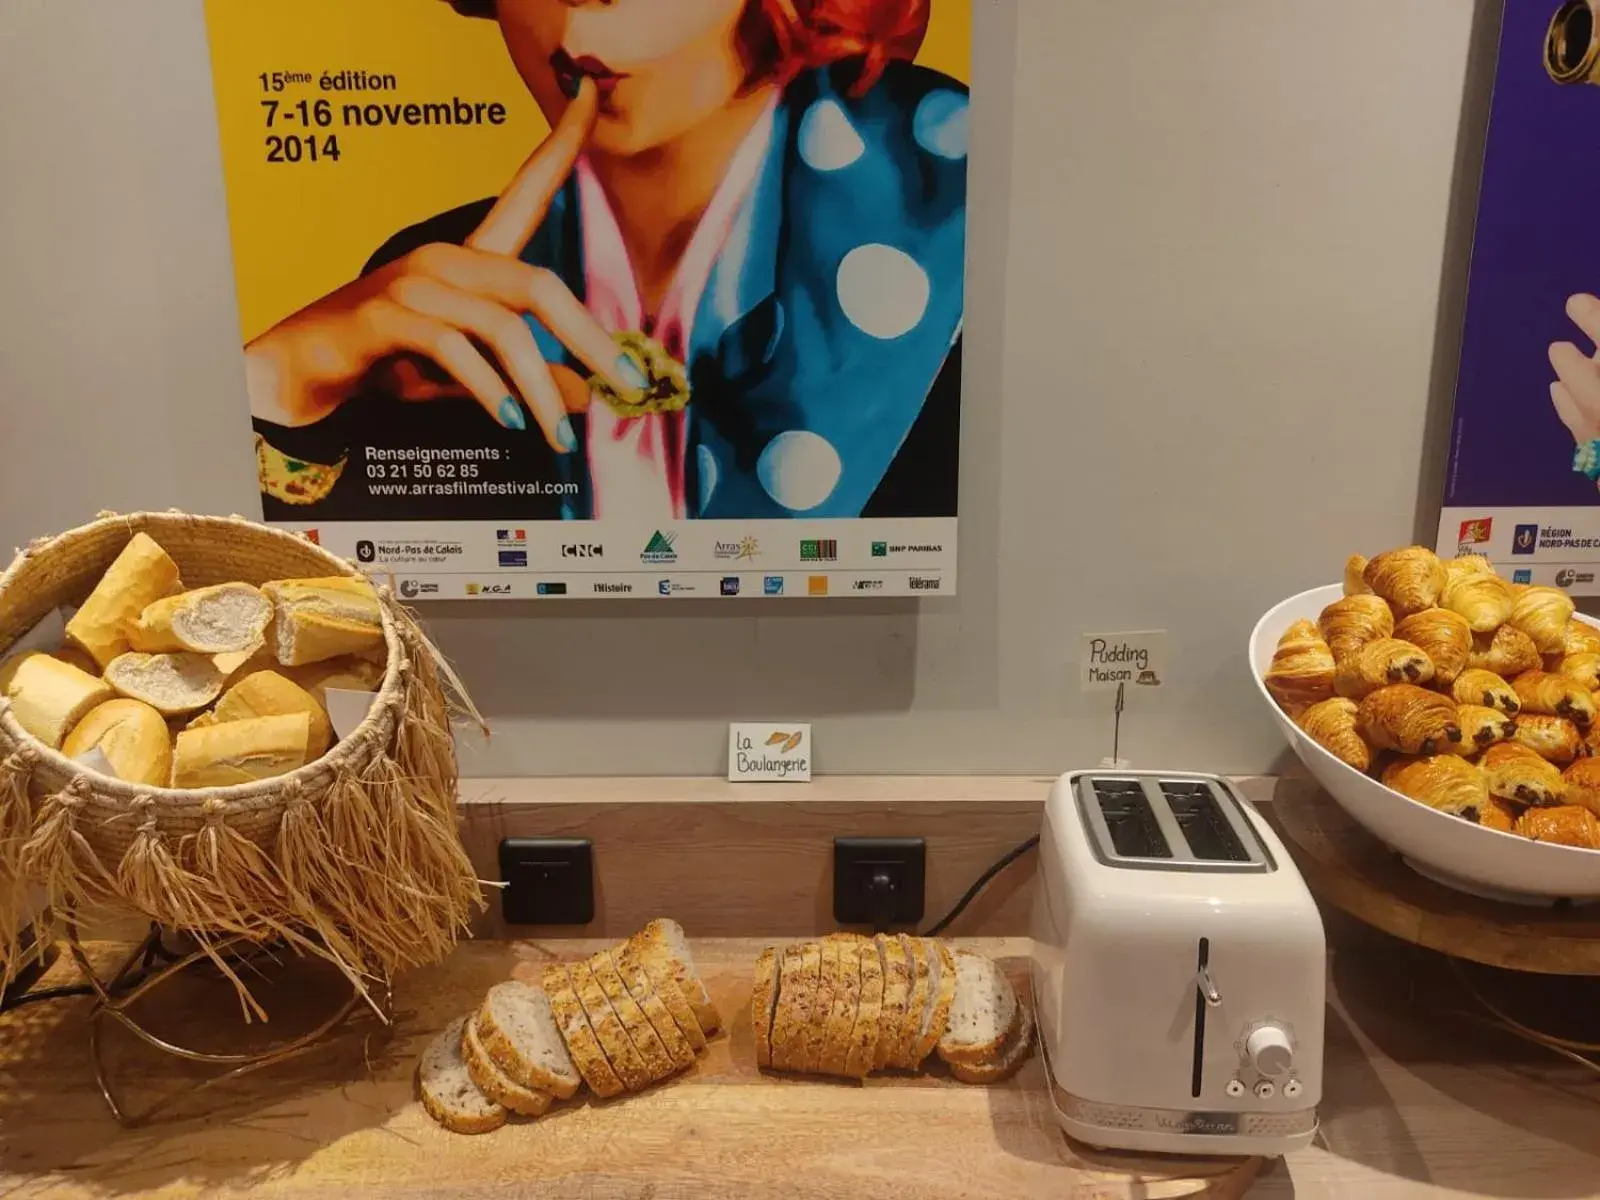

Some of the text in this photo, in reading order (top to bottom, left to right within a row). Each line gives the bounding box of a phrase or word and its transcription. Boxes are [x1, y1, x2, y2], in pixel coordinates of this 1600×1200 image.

[258, 71, 396, 92] 15ème édition
[261, 97, 506, 128] 7-16 novembre
[266, 135, 340, 163] 2014
[365, 446, 500, 464] Renseignements
[366, 464, 479, 478] 03 21 50 62 85
[368, 481, 578, 496] www.arrasfilmfestival.com
[1541, 526, 1572, 538] RÉGION
[423, 545, 433, 554] de
[436, 545, 463, 554] Calais
[715, 541, 741, 550] Arras
[1090, 638, 1148, 670] Pudding
[1089, 667, 1132, 682] Maison
[736, 730, 753, 750] La
[736, 752, 807, 777] Boulangerie
